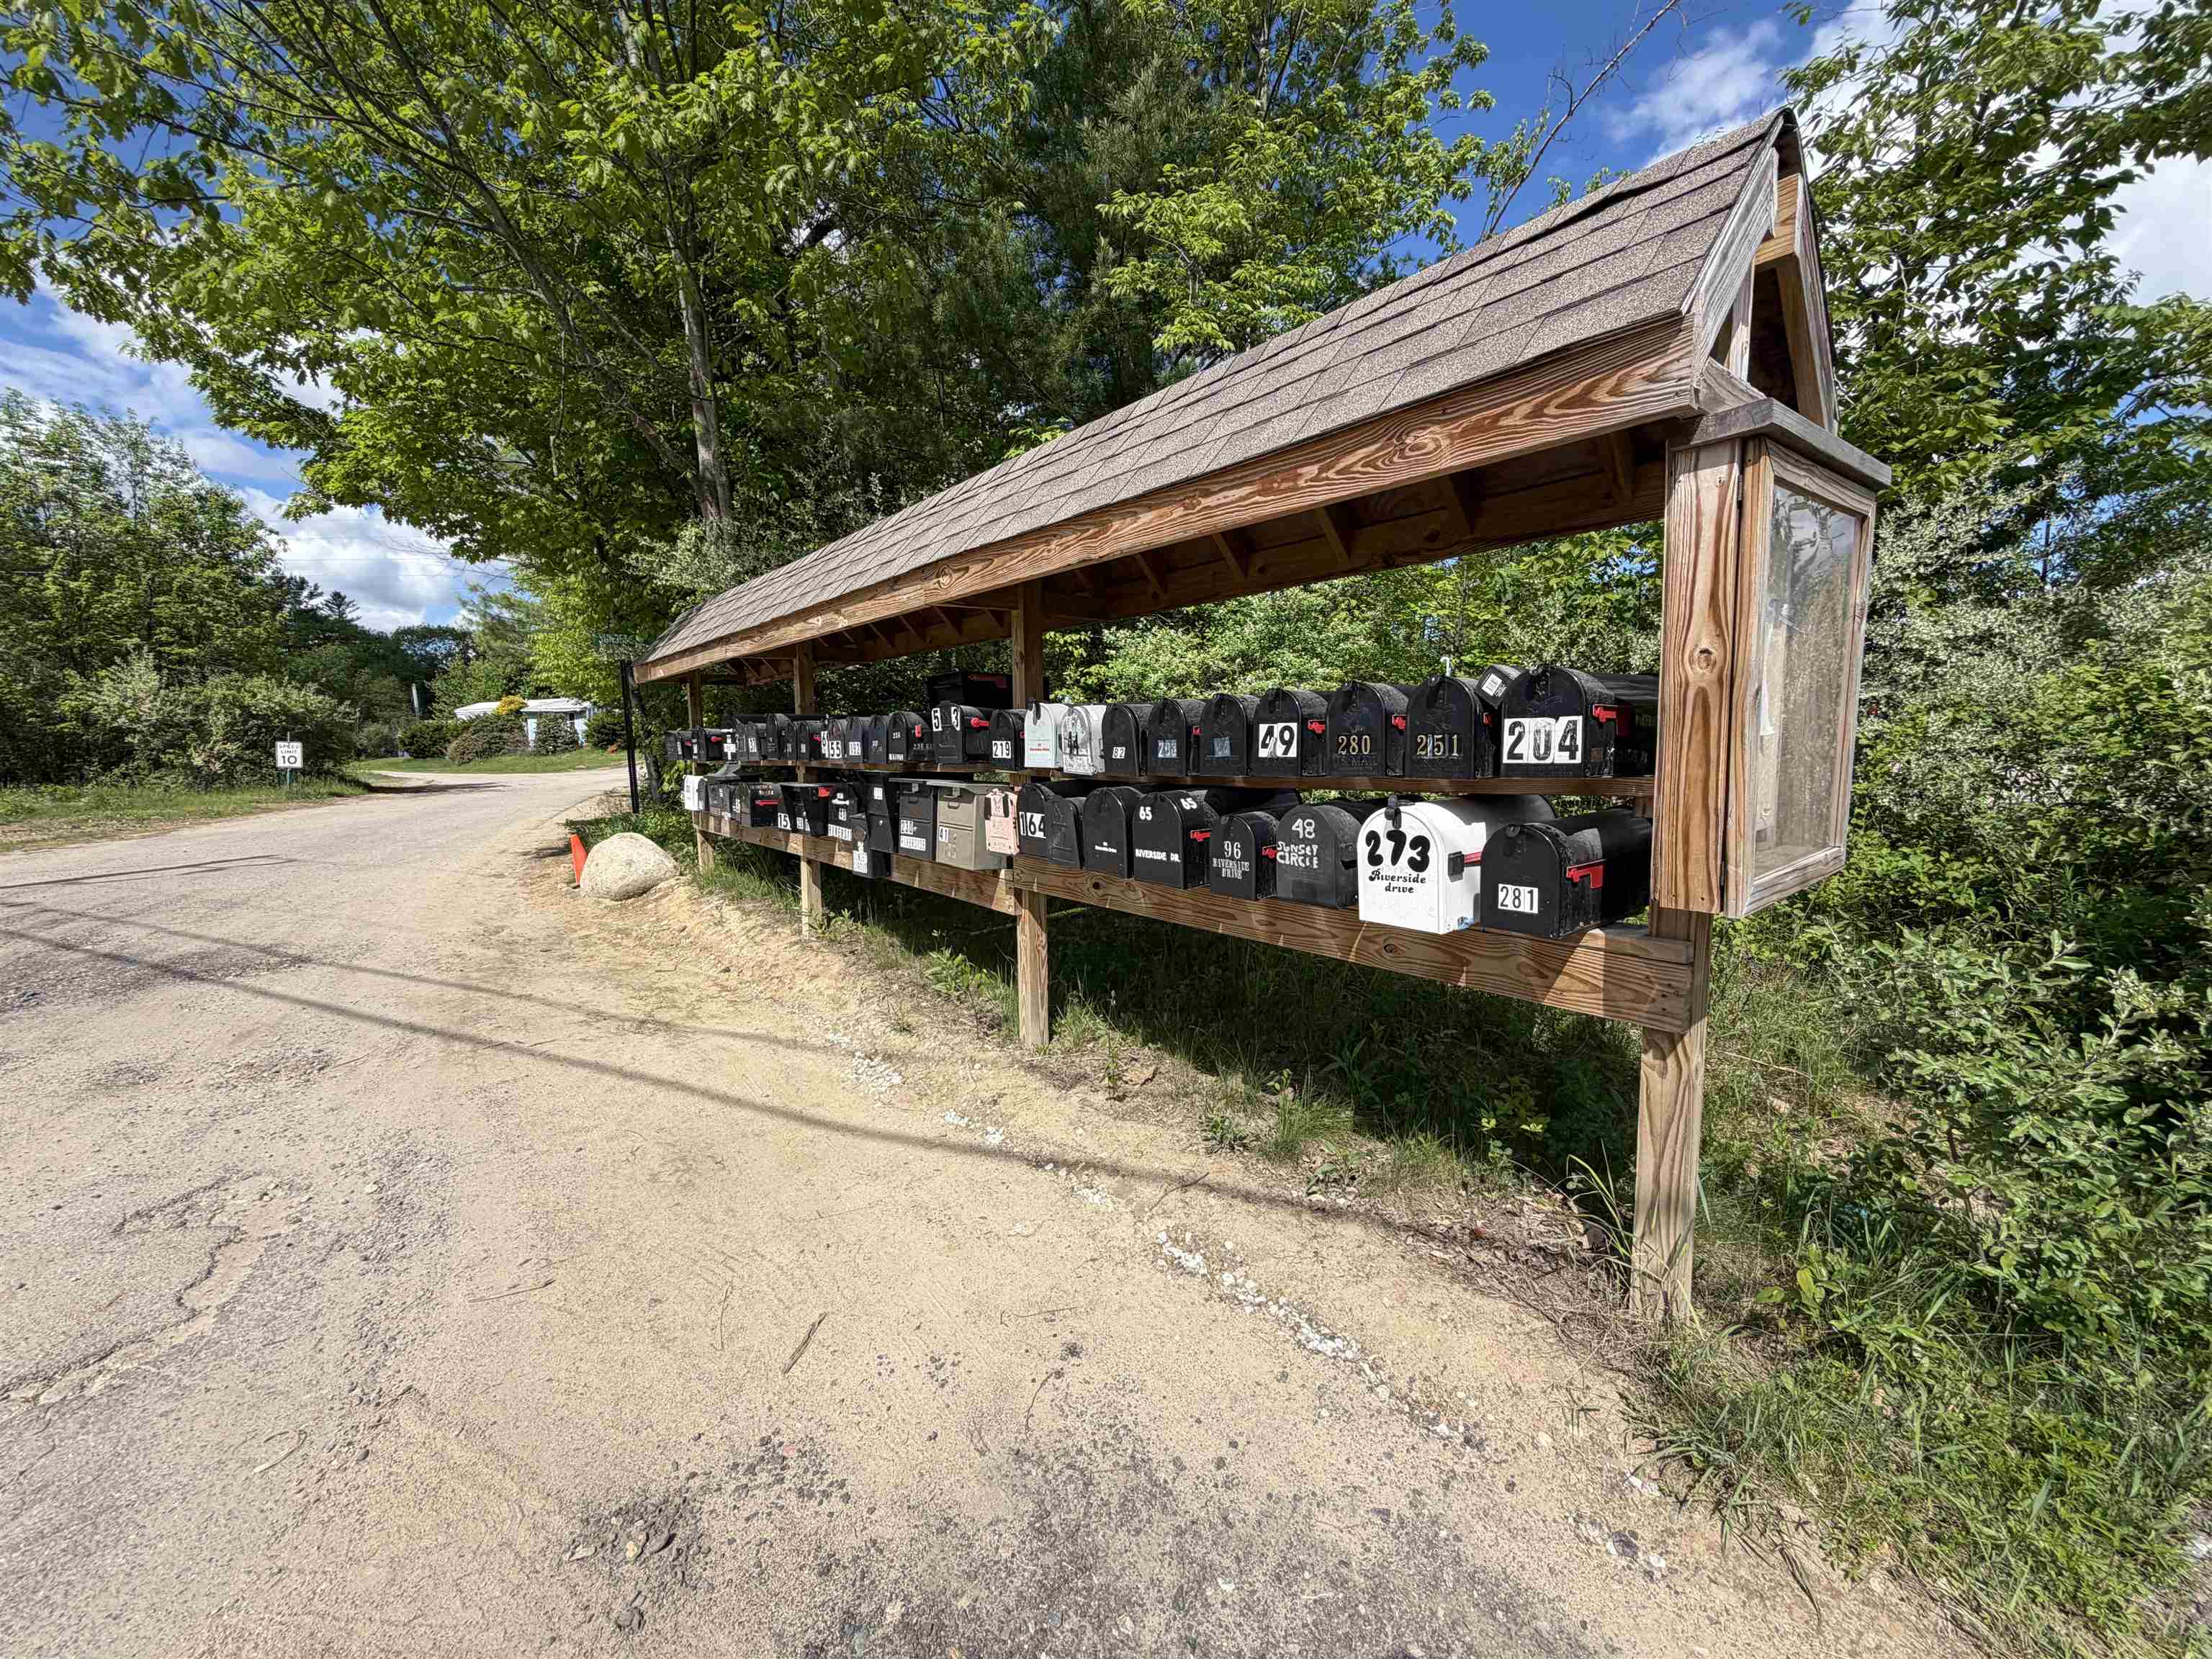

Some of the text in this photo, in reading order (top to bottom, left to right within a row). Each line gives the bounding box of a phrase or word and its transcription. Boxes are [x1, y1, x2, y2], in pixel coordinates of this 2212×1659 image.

[1261, 725, 1295, 756] 49
[1338, 736, 1371, 755] 280
[1416, 734, 1458, 755] 251
[1508, 720, 1579, 761] 204
[994, 742, 1010, 757] 219
[282, 755, 297, 764] 10
[1180, 797, 1197, 810] 65
[1139, 806, 1152, 821] 65
[1292, 818, 1316, 839] 48
[1135, 848, 1167, 861] RIVERSIDE
[1223, 841, 1241, 859] 96
[1365, 830, 1431, 873] 273
[1213, 858, 1250, 871] RIVERSIDE
[1277, 852, 1318, 868] CIRCLE
[1222, 868, 1243, 879] DRIVE
[1369, 868, 1426, 884] Riverside
[1385, 883, 1414, 894] drive
[1500, 886, 1537, 911] 281
